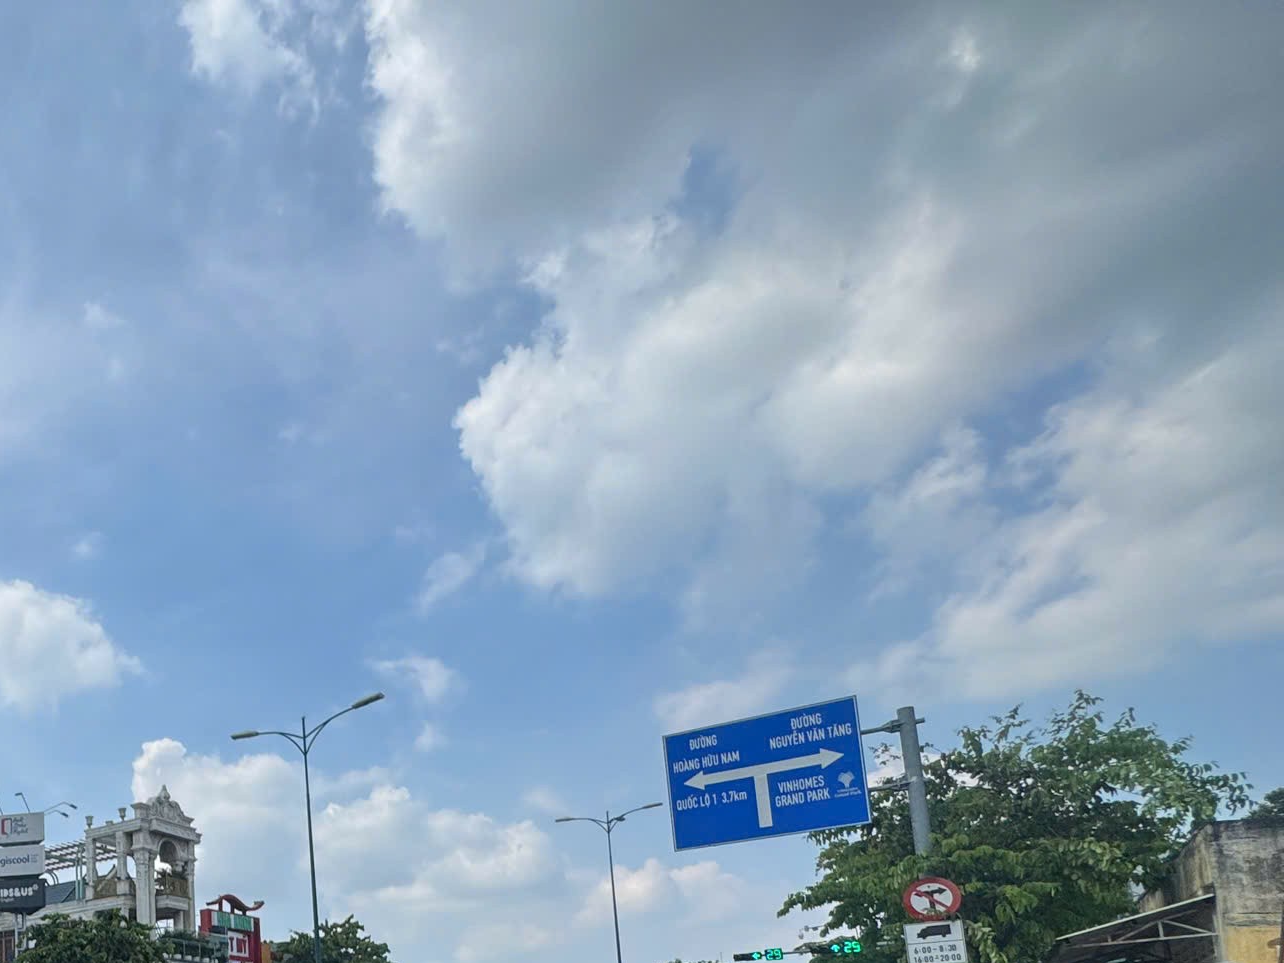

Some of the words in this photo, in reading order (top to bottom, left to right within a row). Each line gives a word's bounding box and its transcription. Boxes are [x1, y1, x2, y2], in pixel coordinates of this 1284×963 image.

[790, 713, 822, 730] ĐƯỜNG
[689, 734, 718, 751] ĐƯỜNG
[769, 732, 805, 750] NGUYỄN
[806, 727, 826, 742] VĂN
[828, 723, 852, 739] TĂNG
[673, 757, 700, 774] HOÀNG
[702, 753, 719, 767] HỮU
[721, 750, 740, 764] NAM
[777, 775, 825, 793] VINHOMES
[676, 793, 699, 811] QUỐC
[700, 793, 710, 809] LỘ
[712, 794, 717, 805] 1
[775, 792, 805, 808] GRAND
[806, 788, 830, 803] PARK
